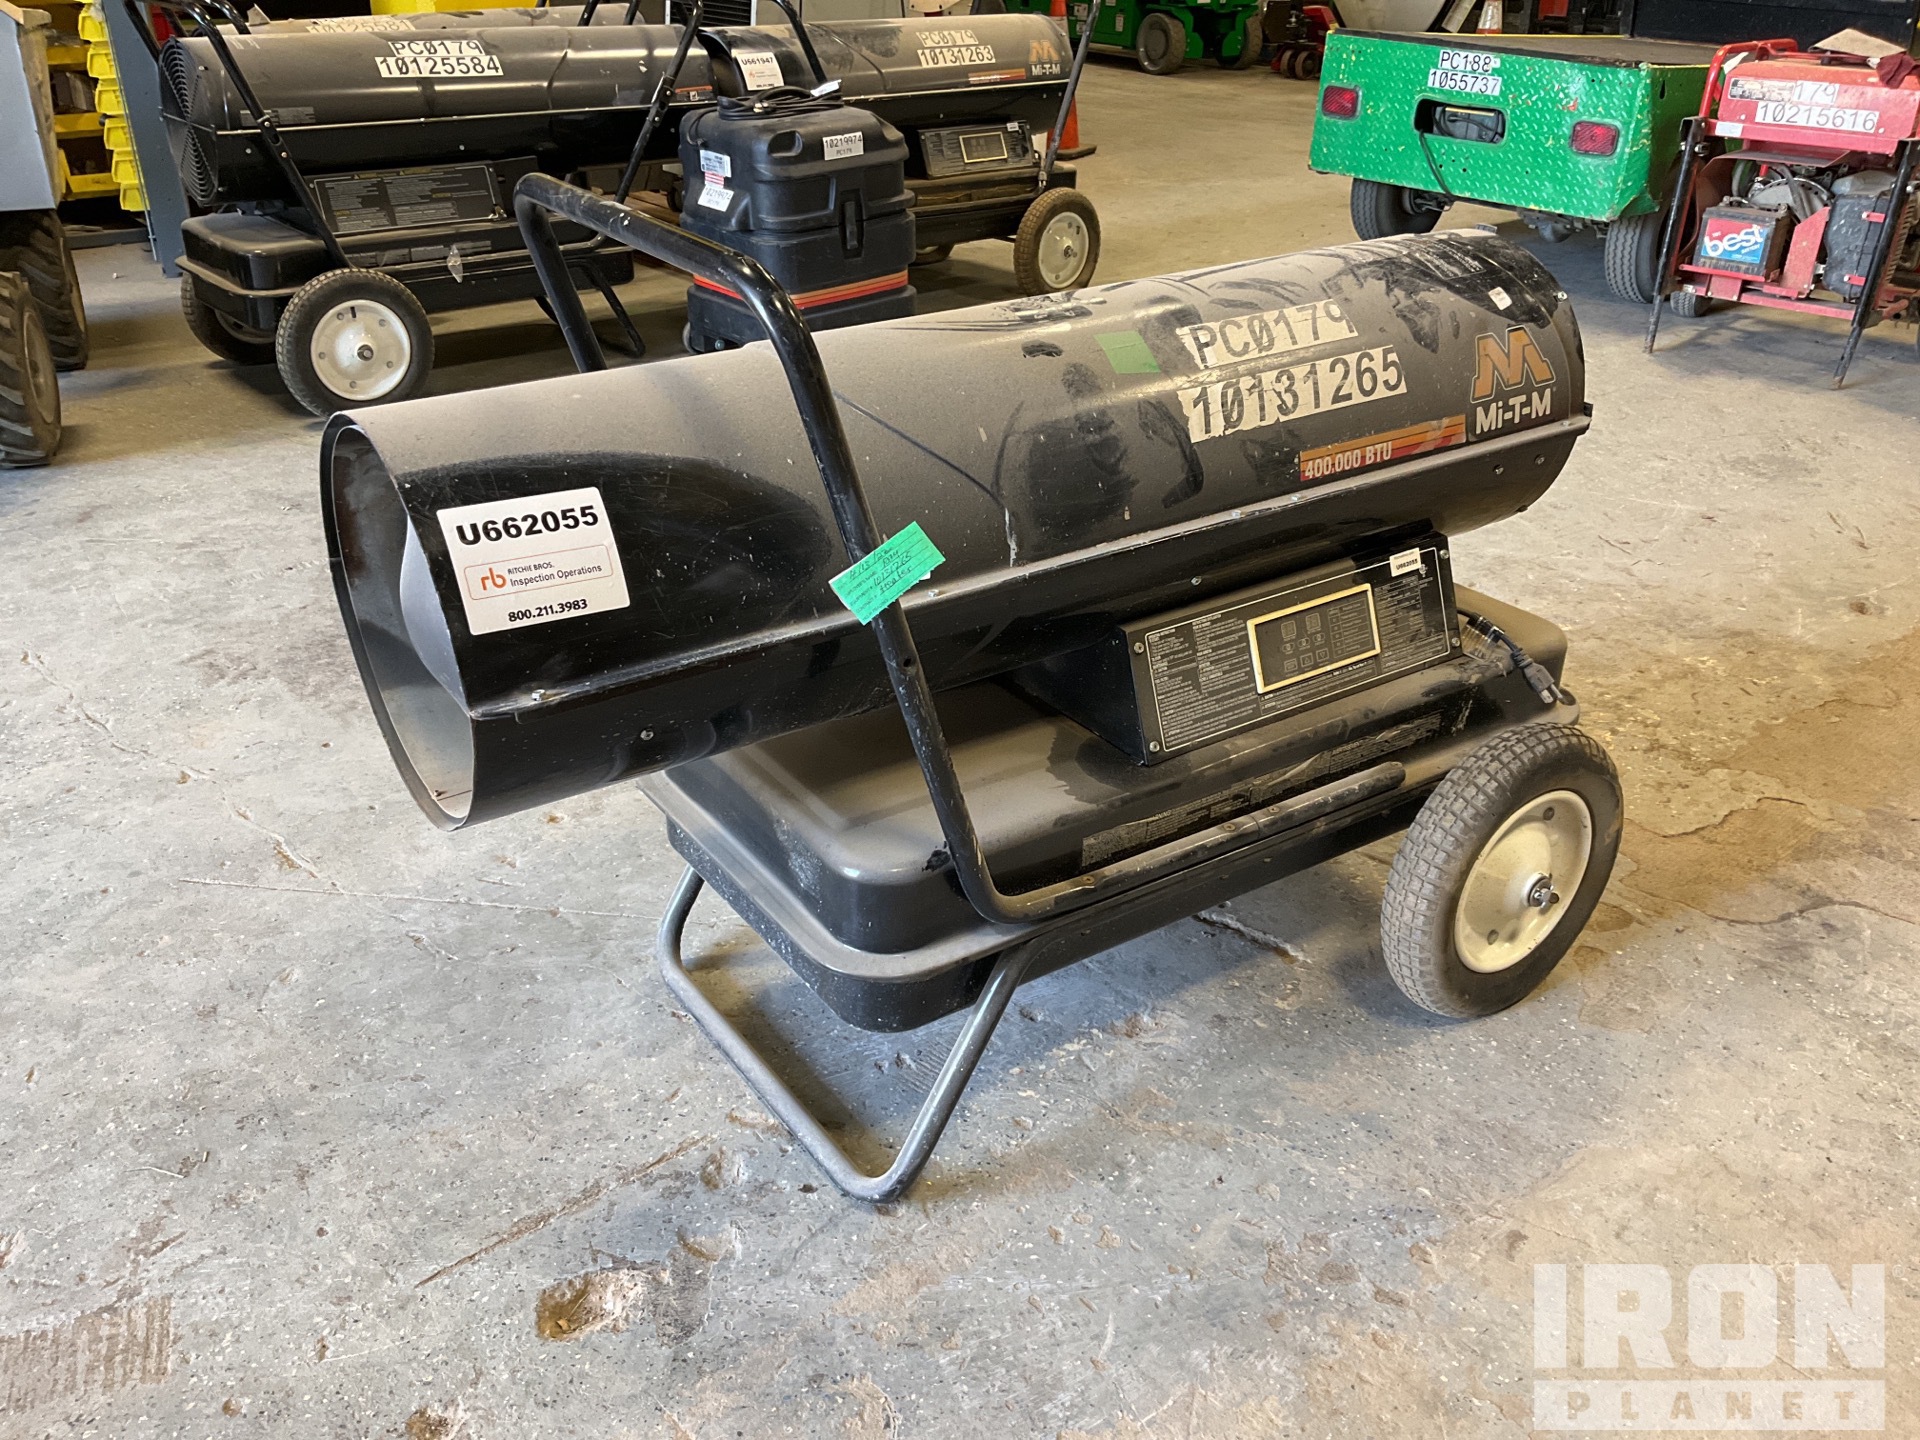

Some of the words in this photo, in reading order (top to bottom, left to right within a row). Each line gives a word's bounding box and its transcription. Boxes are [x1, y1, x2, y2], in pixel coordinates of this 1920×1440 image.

[391, 41, 483, 55] PC0179
[921, 30, 978, 45] PC0179
[380, 56, 500, 75] 10125584
[920, 46, 994, 66] 10131263
[1031, 64, 1061, 76] Mi-T-M
[1431, 70, 1500, 94] 1055737
[1760, 103, 1877, 131] 10215616
[1704, 224, 1763, 257] best
[1189, 300, 1356, 369] PC0179
[1193, 348, 1403, 435] 10131265
[1475, 388, 1551, 435] Mi-T-M
[1366, 441, 1392, 465] BTU
[456, 504, 599, 546] U662055
[507, 564, 533, 575] RITCHIE
[533, 561, 555, 571] BROS.
[510, 569, 556, 587] Inspection
[557, 564, 603, 580] Operations
[508, 598, 588, 622] 800.211.3983
